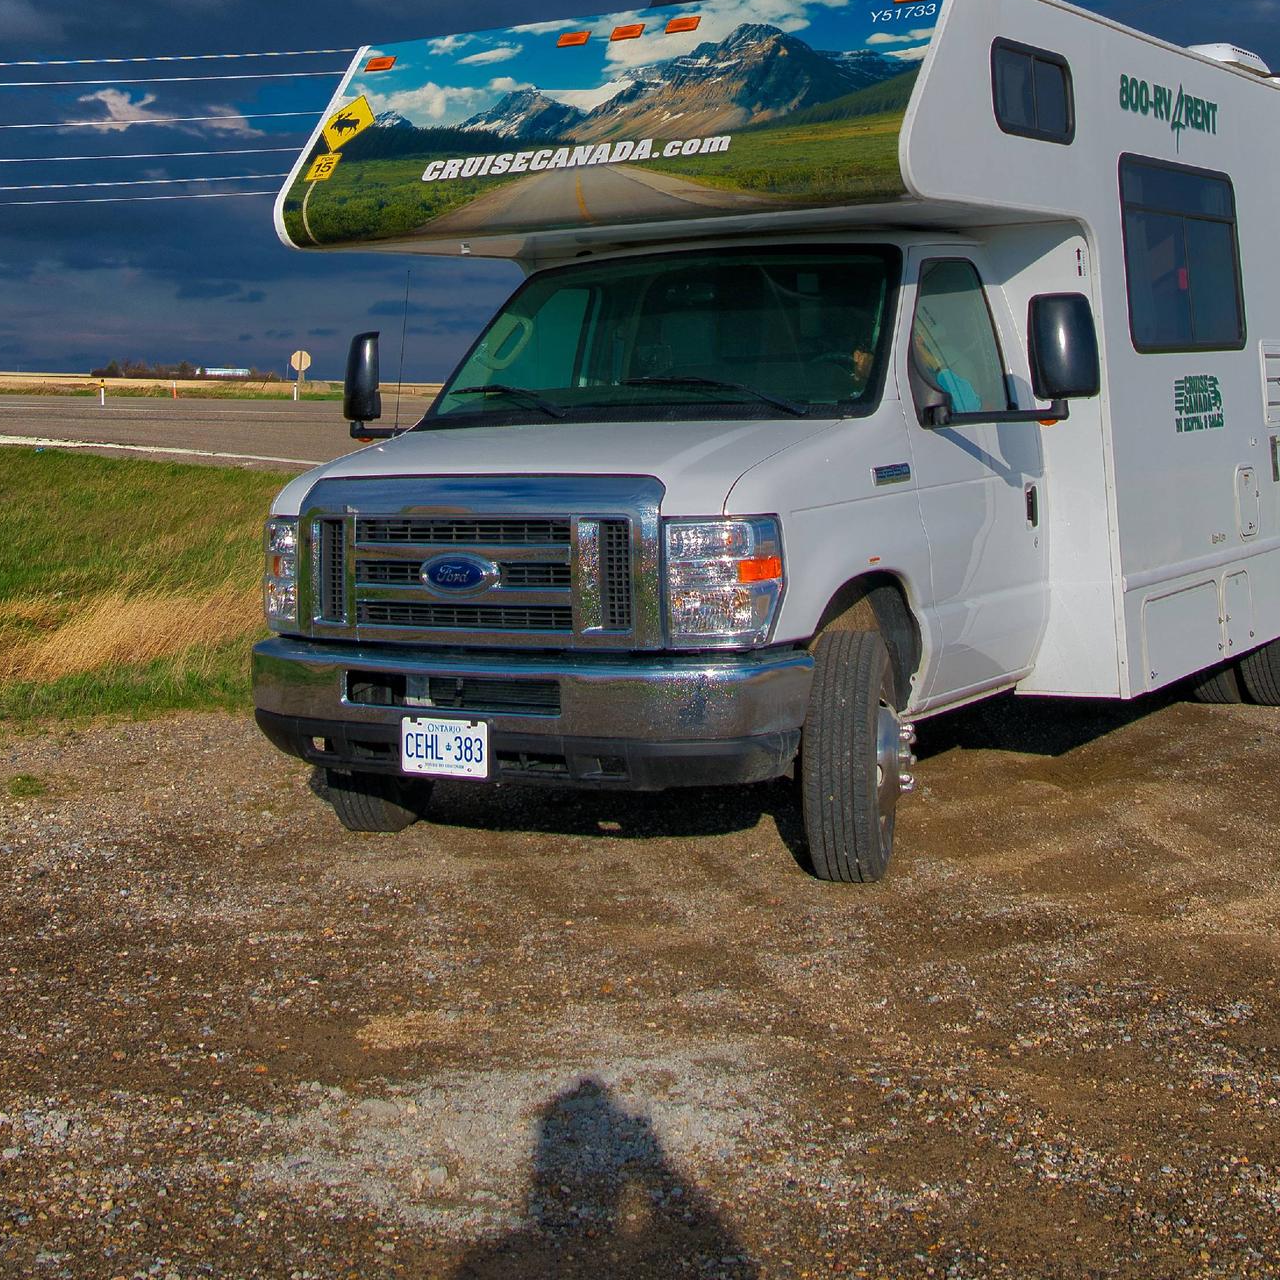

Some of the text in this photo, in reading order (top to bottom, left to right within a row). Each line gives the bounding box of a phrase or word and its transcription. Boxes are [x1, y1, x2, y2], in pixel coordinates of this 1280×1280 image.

[871, 3, 936, 23] Y51733
[315, 162, 333, 173] 15
[421, 135, 732, 182] CRUISECANADA.com
[1184, 375, 1209, 395] CRUISE
[1184, 392, 1213, 414] CANADA
[436, 564, 470, 583] Ford
[427, 723, 462, 734] ONTARIO
[405, 732, 483, 763] CEHL 383
